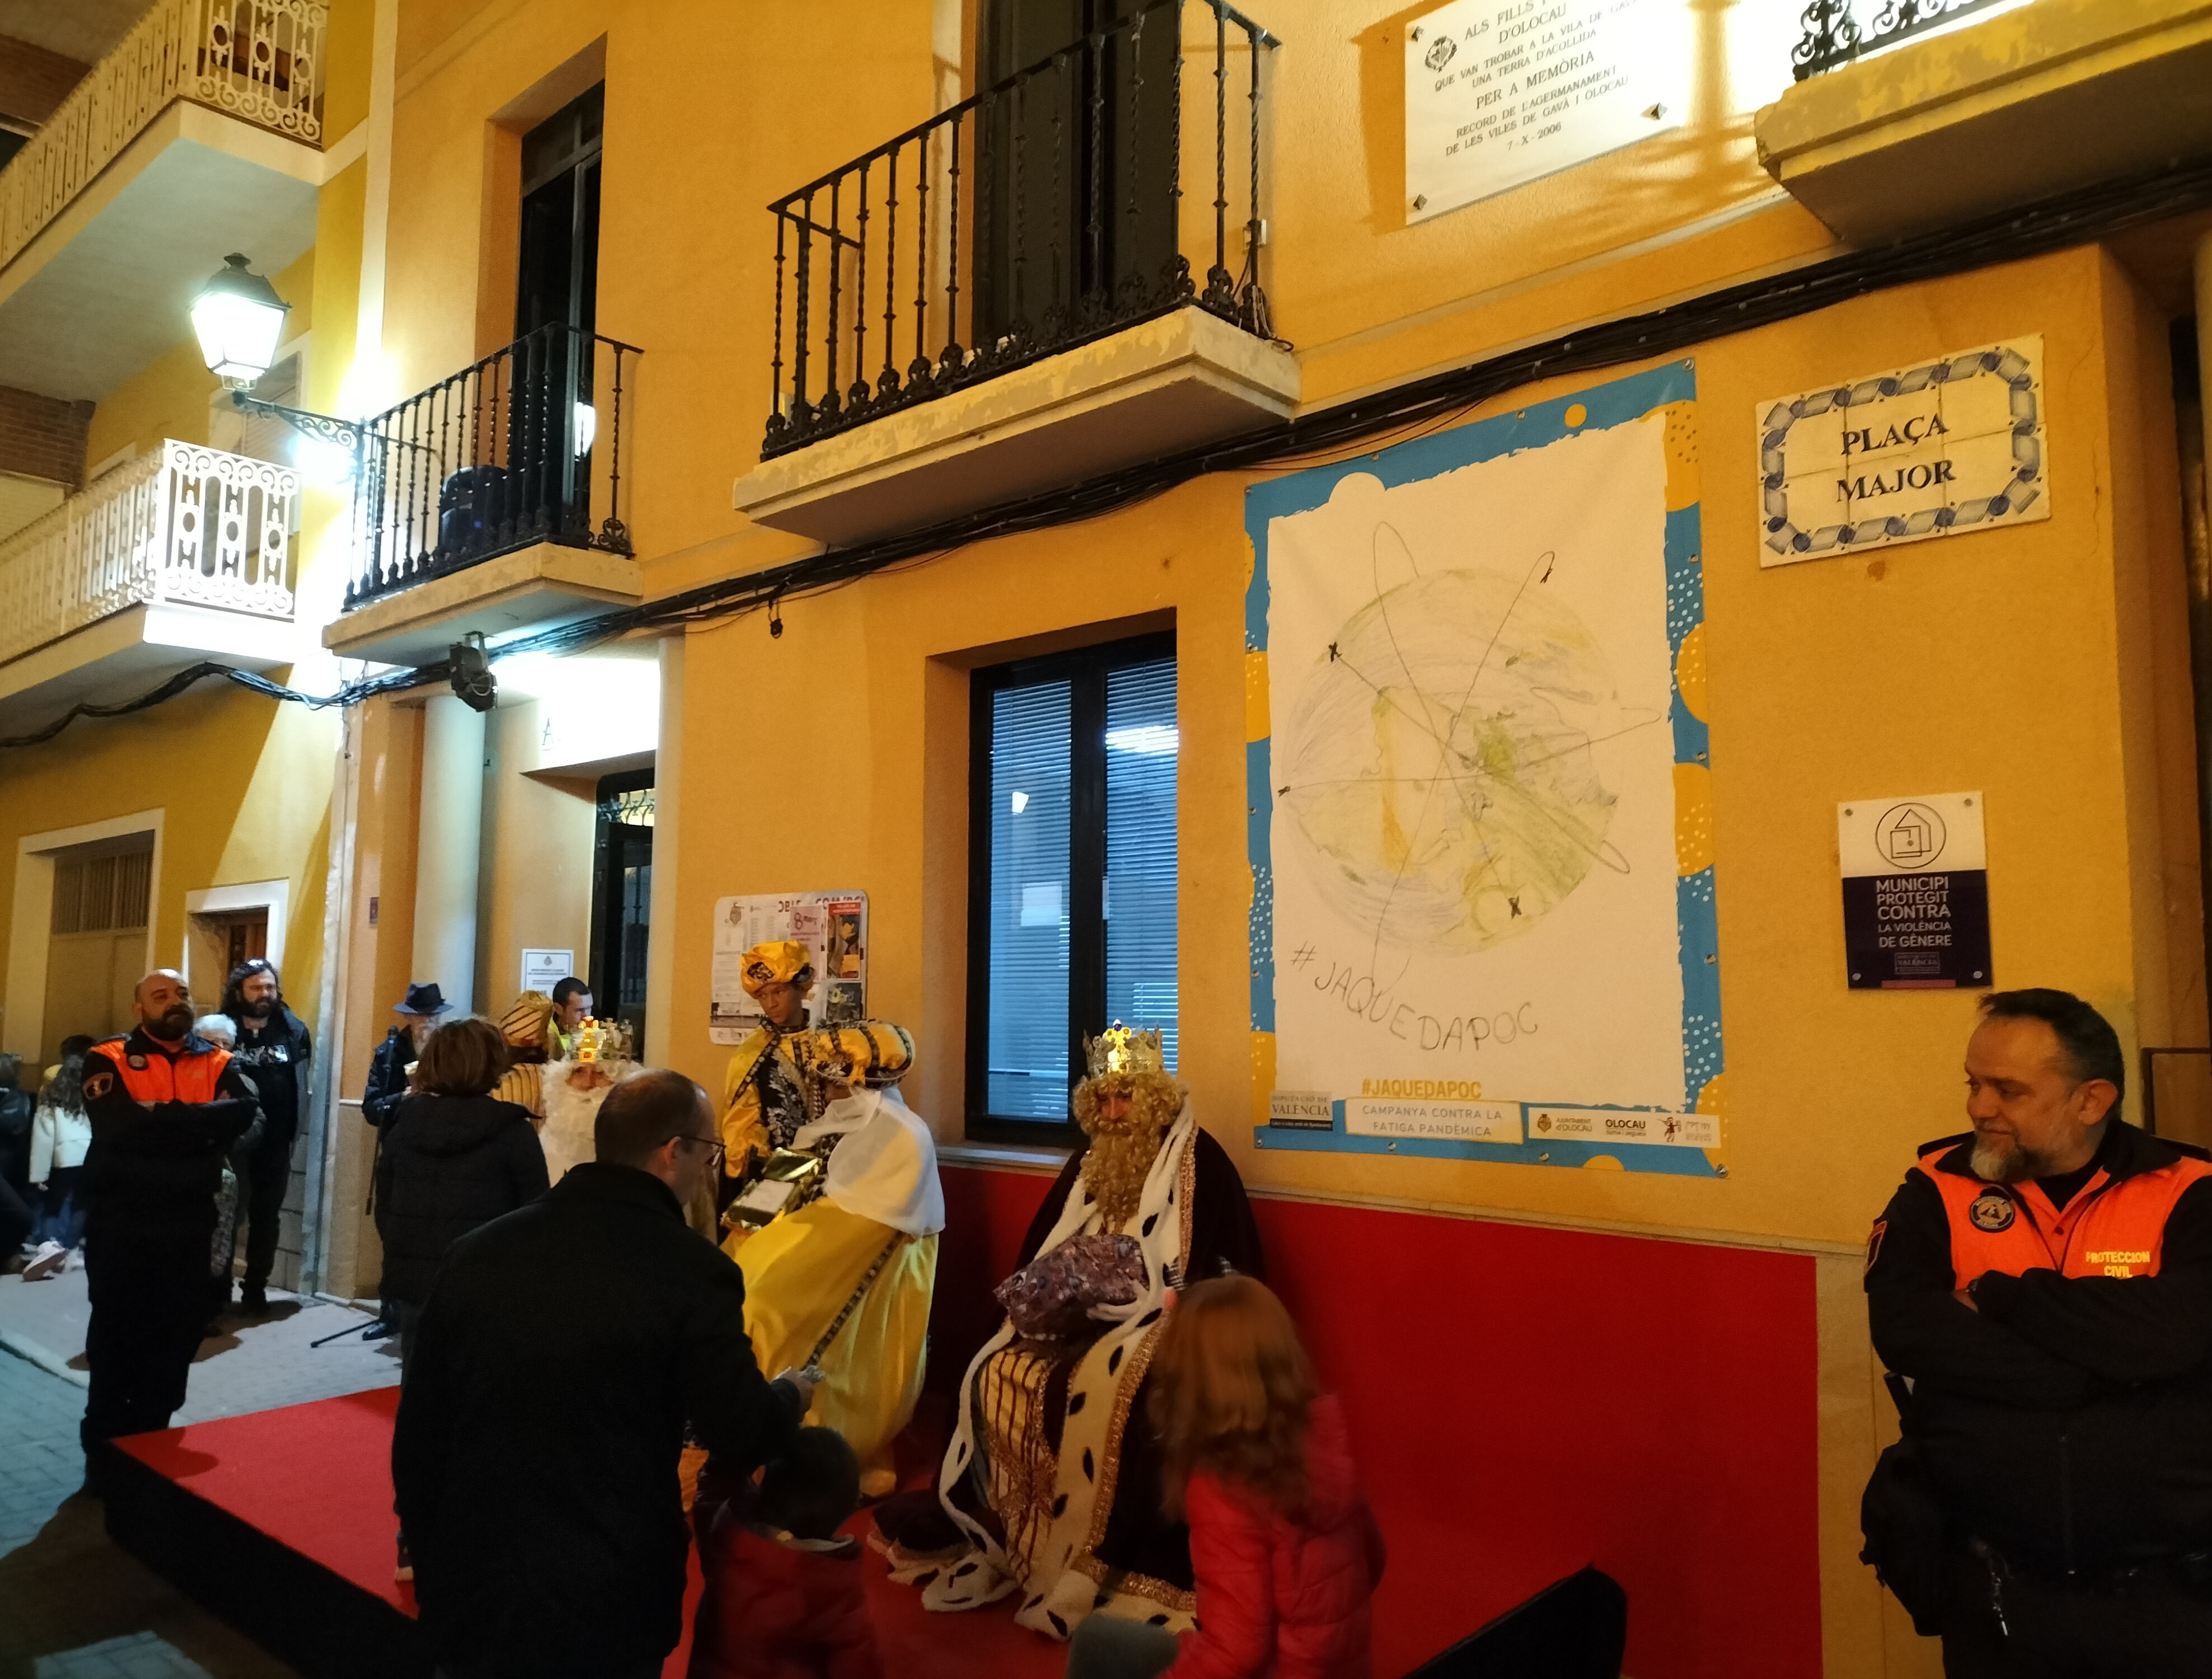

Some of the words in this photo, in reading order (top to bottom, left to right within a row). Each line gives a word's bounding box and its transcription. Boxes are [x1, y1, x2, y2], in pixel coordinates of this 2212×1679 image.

[1465, 18, 1489, 40] ALS
[1497, 0, 1534, 26] FILLS
[1499, 3, 1566, 44] D'OLOCAU
[1435, 74, 1455, 92] QUE
[1461, 64, 1478, 79] VAN
[1484, 44, 1524, 69] TROBAR
[1530, 40, 1536, 50] A
[1542, 32, 1554, 44] LA
[1560, 20, 1583, 36] VILA
[1590, 10, 1603, 24] DE
[1472, 73, 1492, 88] UNA
[1497, 57, 1531, 77] TERRA
[1536, 29, 1596, 61] D'ACOLLIDA
[1477, 88, 1502, 110] PER
[1510, 82, 1518, 96] A
[1526, 50, 1594, 89] MEMÒRIA
[1456, 114, 1497, 138] RECORD
[1502, 106, 1516, 120] DE
[1522, 65, 1616, 112] L'AGERMANAMENT
[1446, 143, 1459, 157] DE
[1465, 134, 1483, 149] LES
[1488, 120, 1517, 138] VILES
[1523, 112, 1536, 126] DE
[1543, 97, 1569, 117] GAVÀ
[1576, 95, 1579, 105] I
[1585, 74, 1629, 100] OLOCAU
[1840, 412, 1950, 456] PLAÇA
[1836, 459, 1957, 503] MAJOR
[1876, 876, 1948, 893] MUNICIPI
[1877, 890, 1949, 906] PROTEGIT
[1877, 903, 1951, 920] CONTRA
[1878, 923, 1892, 933] LA
[1895, 920, 1952, 932] VIOLÈNCIA
[1879, 936, 1896, 948] DE
[1899, 933, 1952, 948] GÈNERE
[1362, 1078, 1482, 1099] #JAQUEDAPOC
[1272, 1103, 1330, 1116] VALÈNCIA
[1362, 1105, 1427, 1117] CAMPANYA
[1432, 1107, 1482, 1119] CONTRA
[1487, 1110, 1502, 1120] LA
[1374, 1121, 1415, 1133] FATIGA
[1419, 1122, 1492, 1136] PANDÈMICA
[1605, 1119, 1646, 1129] OLOCAU
[2086, 1251, 2150, 1263] PROTECCION
[2104, 1265, 2134, 1278] CIVIL
